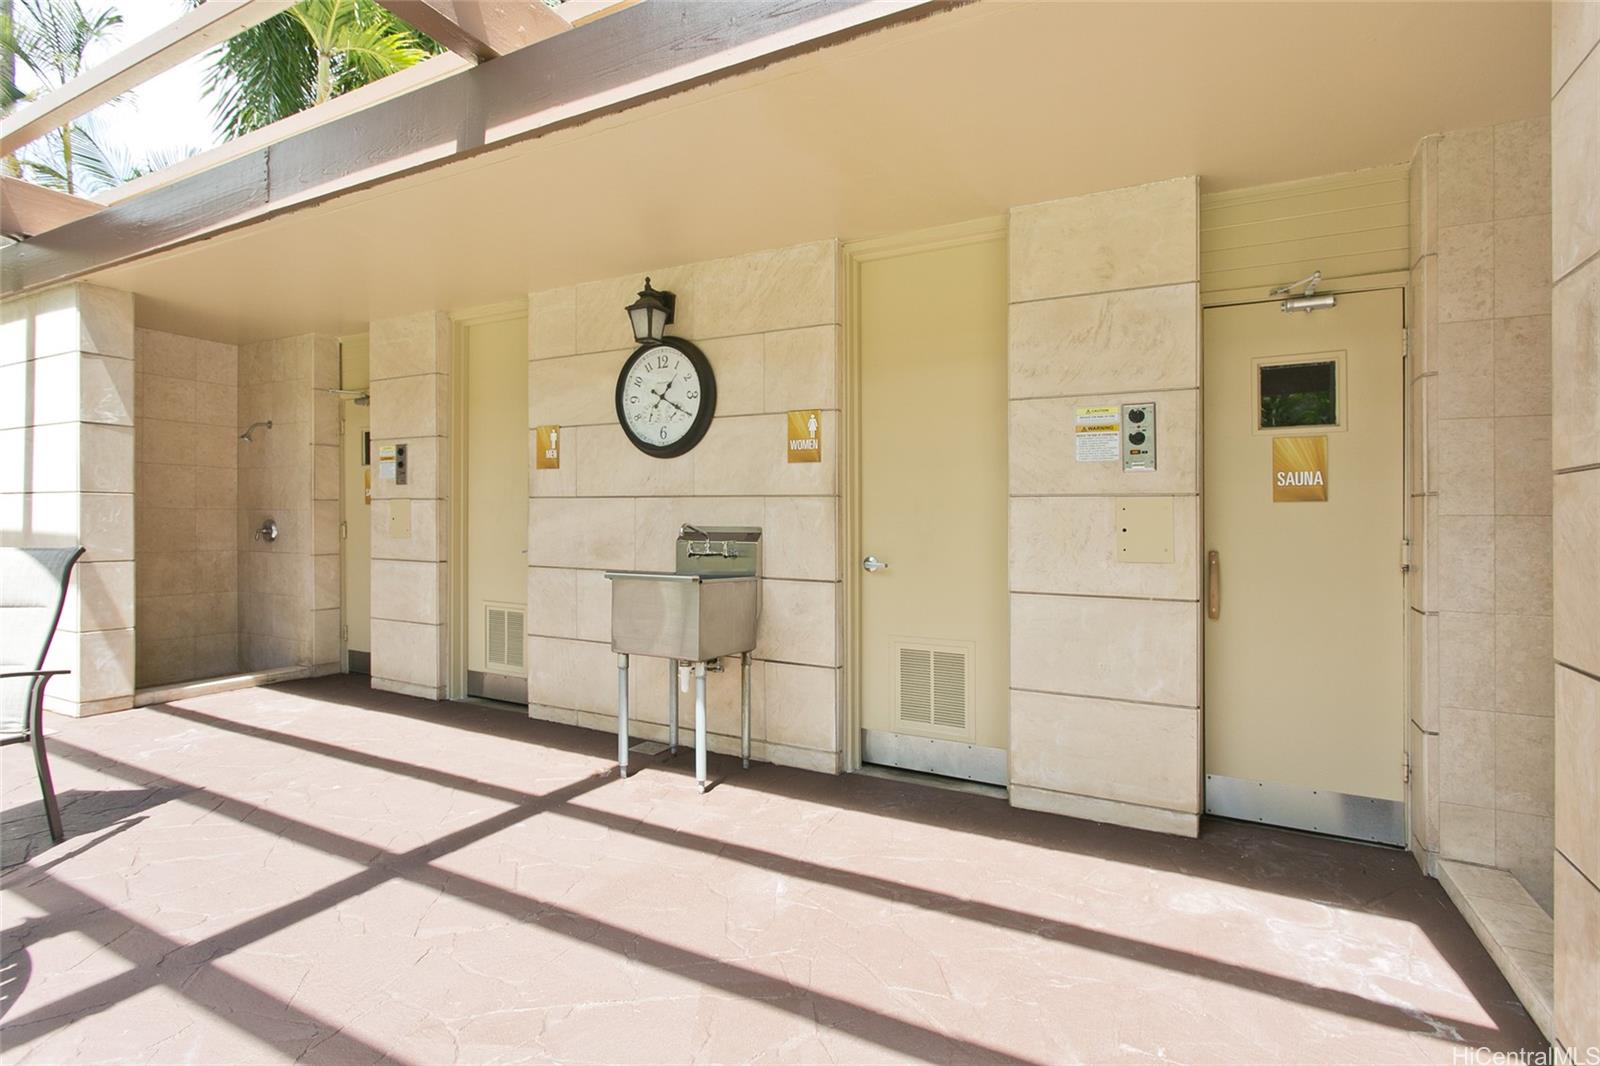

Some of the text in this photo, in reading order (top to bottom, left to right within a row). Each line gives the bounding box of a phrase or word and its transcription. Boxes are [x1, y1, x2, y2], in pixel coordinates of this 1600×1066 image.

[644, 362, 654, 373] 11
[657, 355, 669, 369] 12
[674, 360, 680, 370] 1
[634, 376, 644, 388] 10
[683, 373, 692, 382] 2
[630, 395, 640, 404] 9
[686, 390, 698, 400] 3
[660, 425, 667, 440] 6
[789, 439, 818, 450] WOMEN
[545, 449, 557, 459] MEN
[1276, 470, 1324, 487] SAUNA
